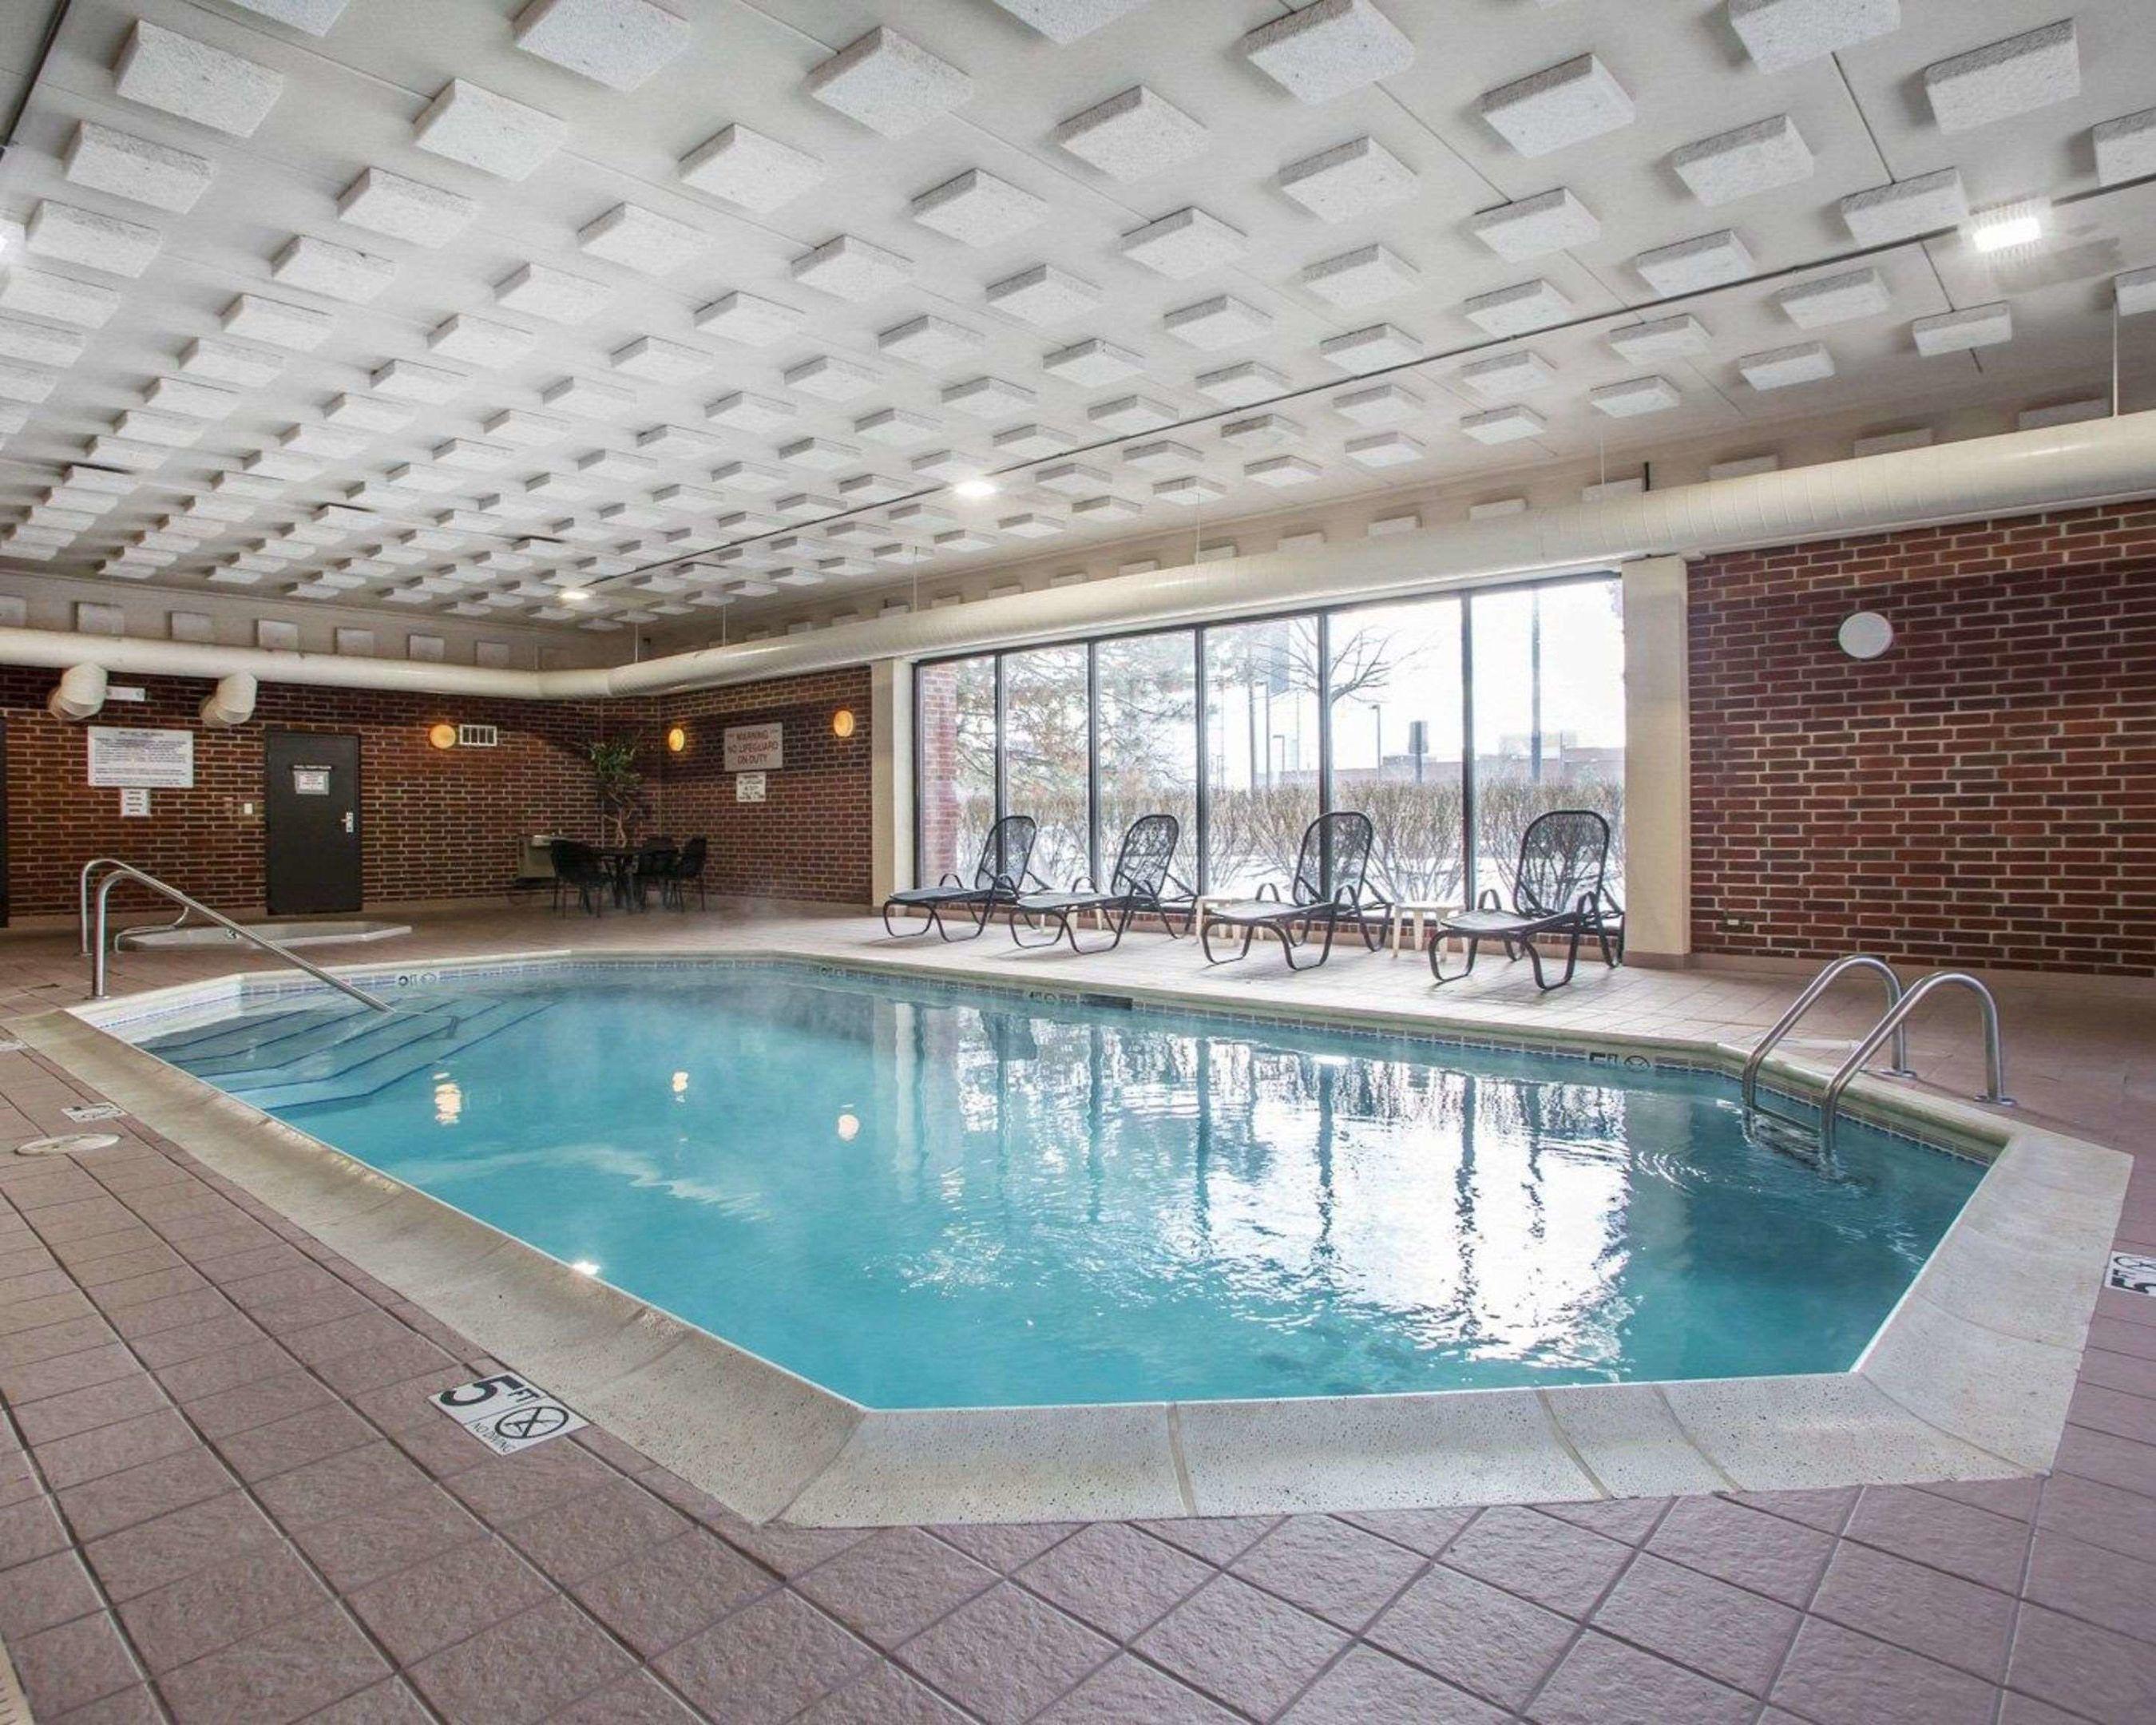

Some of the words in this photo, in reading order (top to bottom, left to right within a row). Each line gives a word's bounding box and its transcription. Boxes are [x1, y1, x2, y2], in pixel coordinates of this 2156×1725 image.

[736, 730, 768, 741] WARNING
[727, 744, 737, 753] NO
[739, 741, 779, 753] LIFEGUARD
[737, 755, 748, 765] ON
[749, 754, 767, 764] DUTY
[438, 1374, 524, 1406] 5
[508, 1387, 541, 1403] FT
[473, 1422, 489, 1434] NO
[482, 1430, 517, 1453] DIVING
